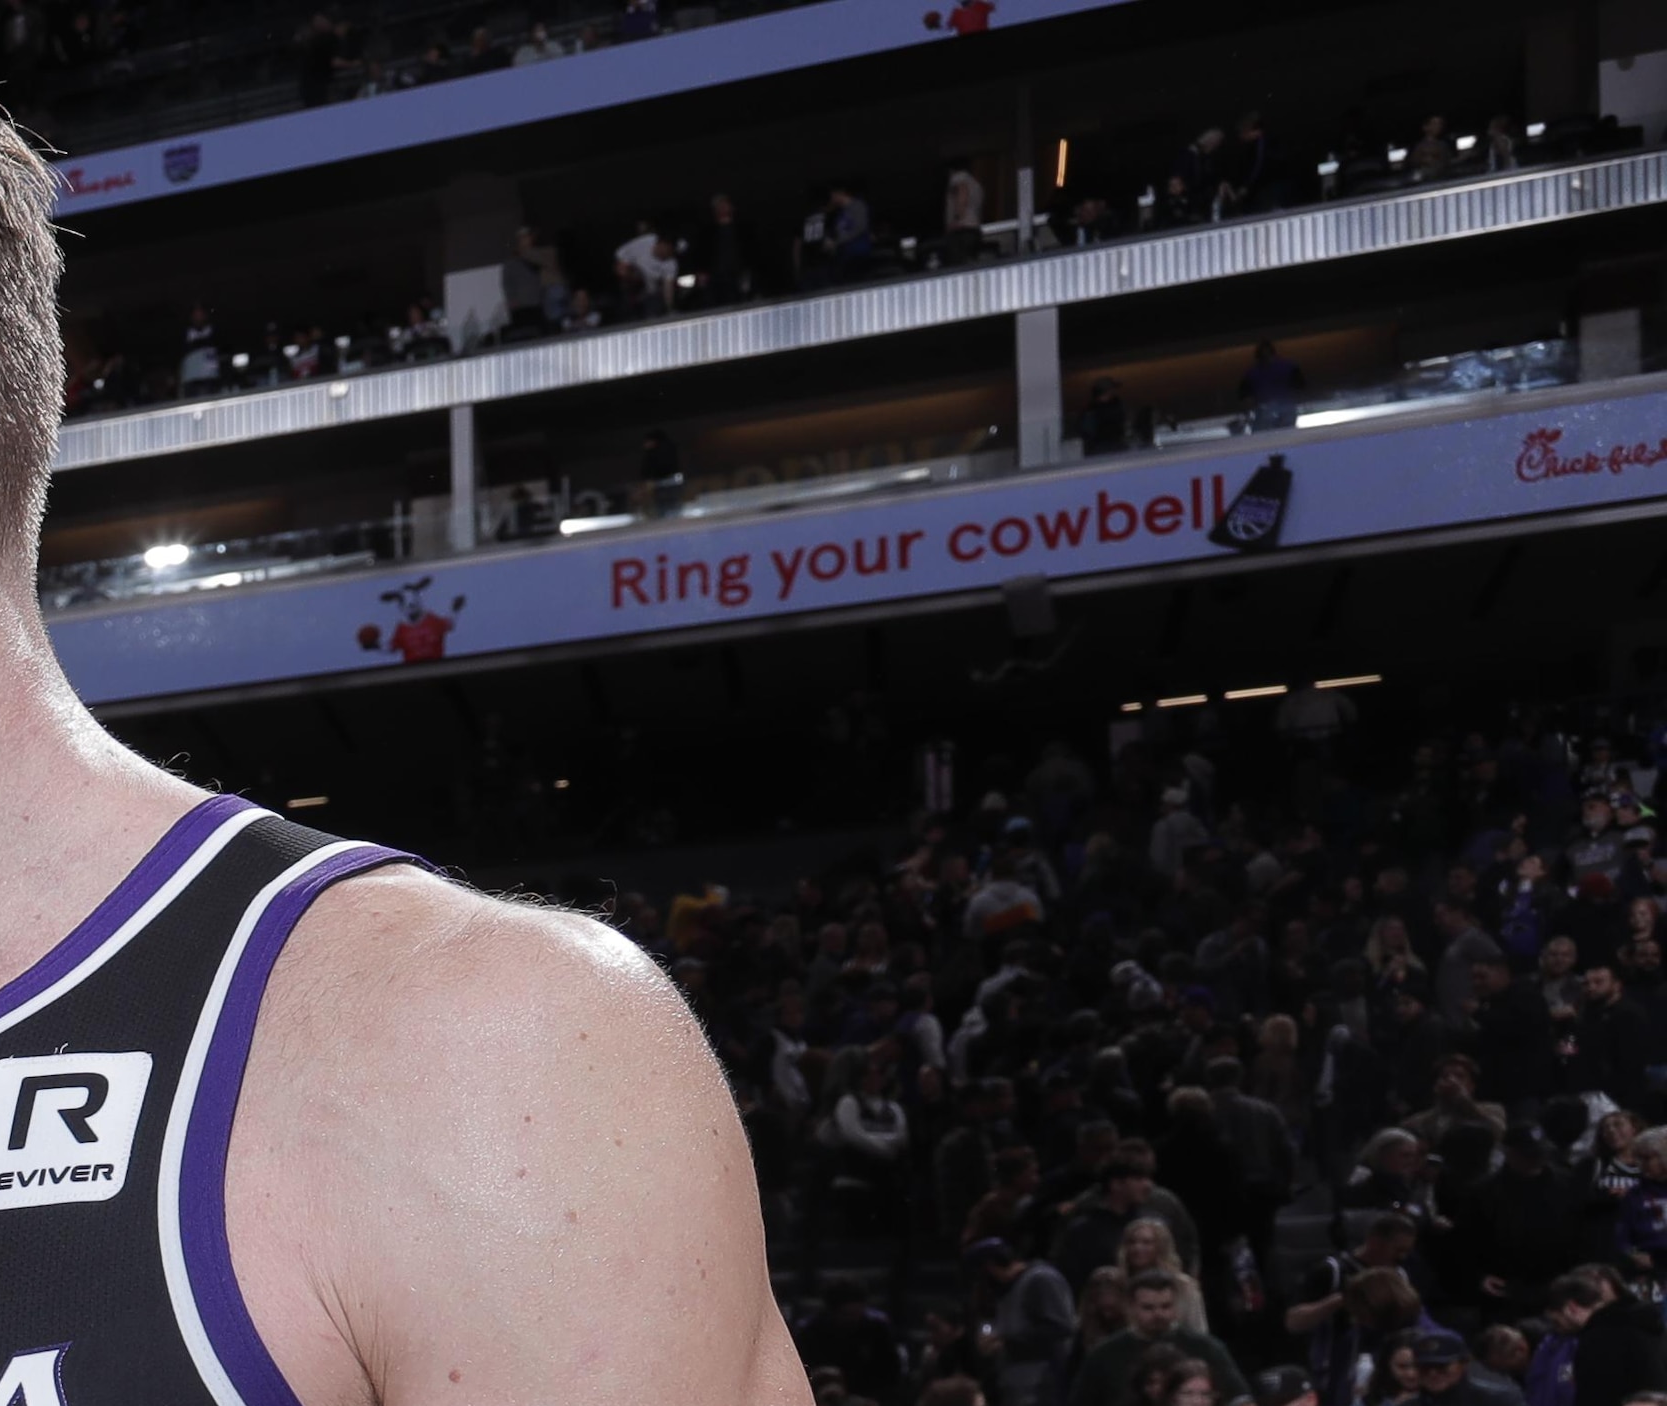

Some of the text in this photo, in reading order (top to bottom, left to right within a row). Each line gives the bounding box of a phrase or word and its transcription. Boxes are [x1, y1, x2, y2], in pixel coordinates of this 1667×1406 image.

[612, 476, 1227, 607] Ring your cowbell
[8, 1072, 109, 1151] R
